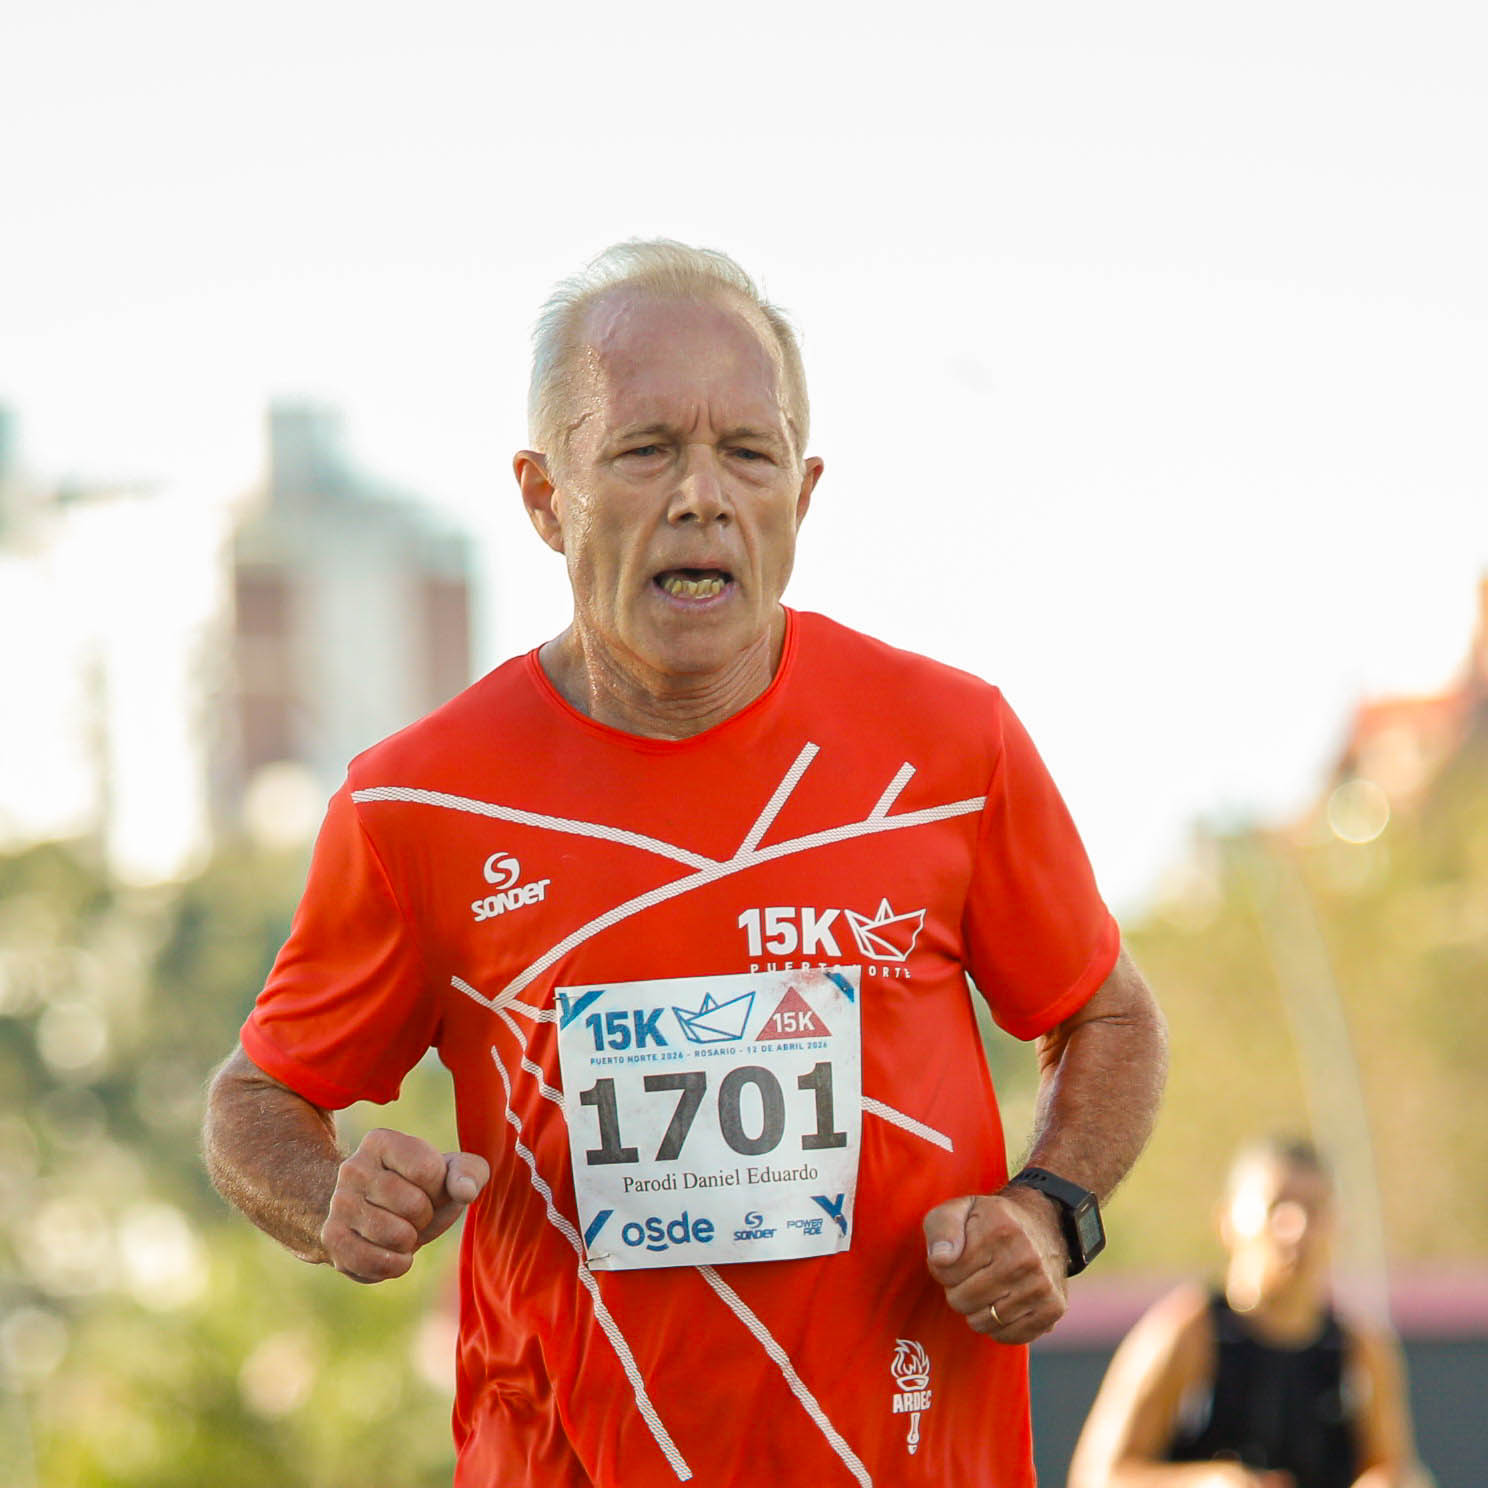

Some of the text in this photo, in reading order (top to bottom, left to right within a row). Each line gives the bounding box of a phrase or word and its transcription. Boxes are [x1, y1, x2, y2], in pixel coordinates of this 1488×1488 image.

[738, 907, 842, 957] 15K
[750, 961, 912, 979] PUERT ORTE
[585, 1008, 668, 1051] 15K
[773, 1011, 815, 1034] 15K
[590, 1040, 828, 1066] PUERTO NORTE 2026 ROSARIO 12 DE ABRIL 2026
[579, 1061, 848, 1166] 1701
[623, 1164, 819, 1193] Parodi Daniel Eduardo
[621, 1210, 715, 1251] osde
